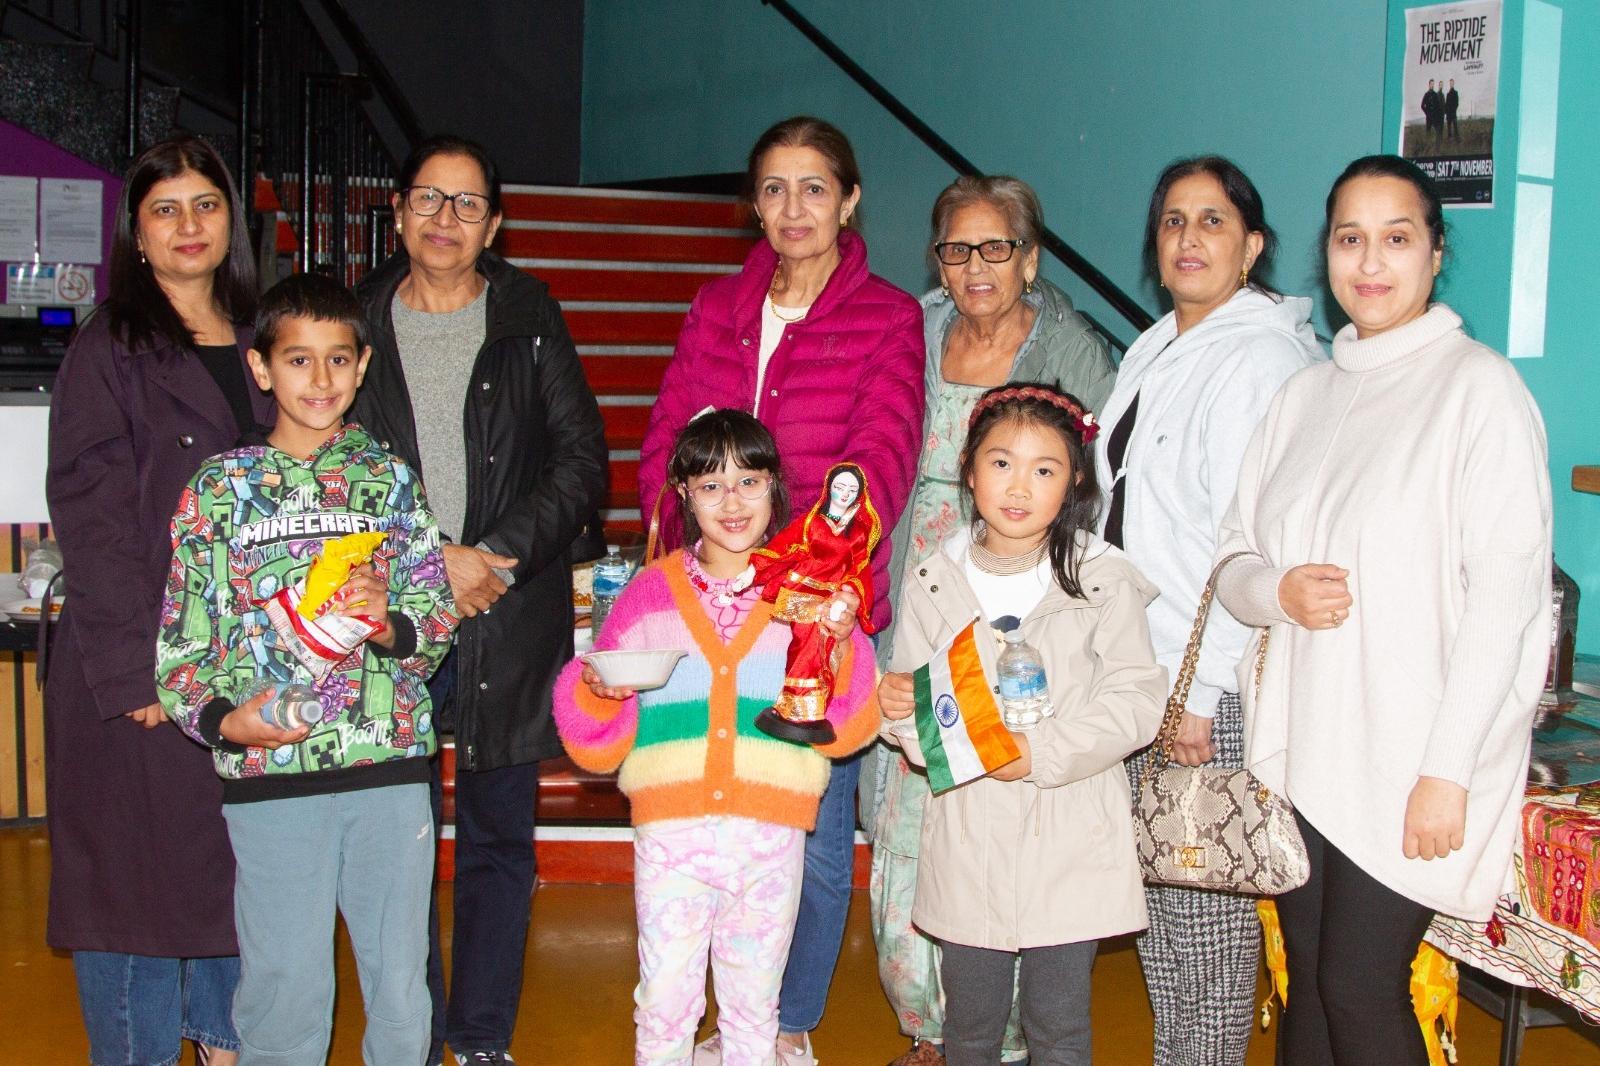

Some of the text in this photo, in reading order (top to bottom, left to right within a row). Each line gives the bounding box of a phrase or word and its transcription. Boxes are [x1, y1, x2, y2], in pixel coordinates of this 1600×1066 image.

[1420, 15, 1487, 44] THE RIPTIDE
[1419, 38, 1484, 65] MOVEMENT
[1438, 160, 1450, 177] SAT
[1460, 159, 1493, 177] NOVEMBER
[241, 512, 377, 548] MINECRAFT
